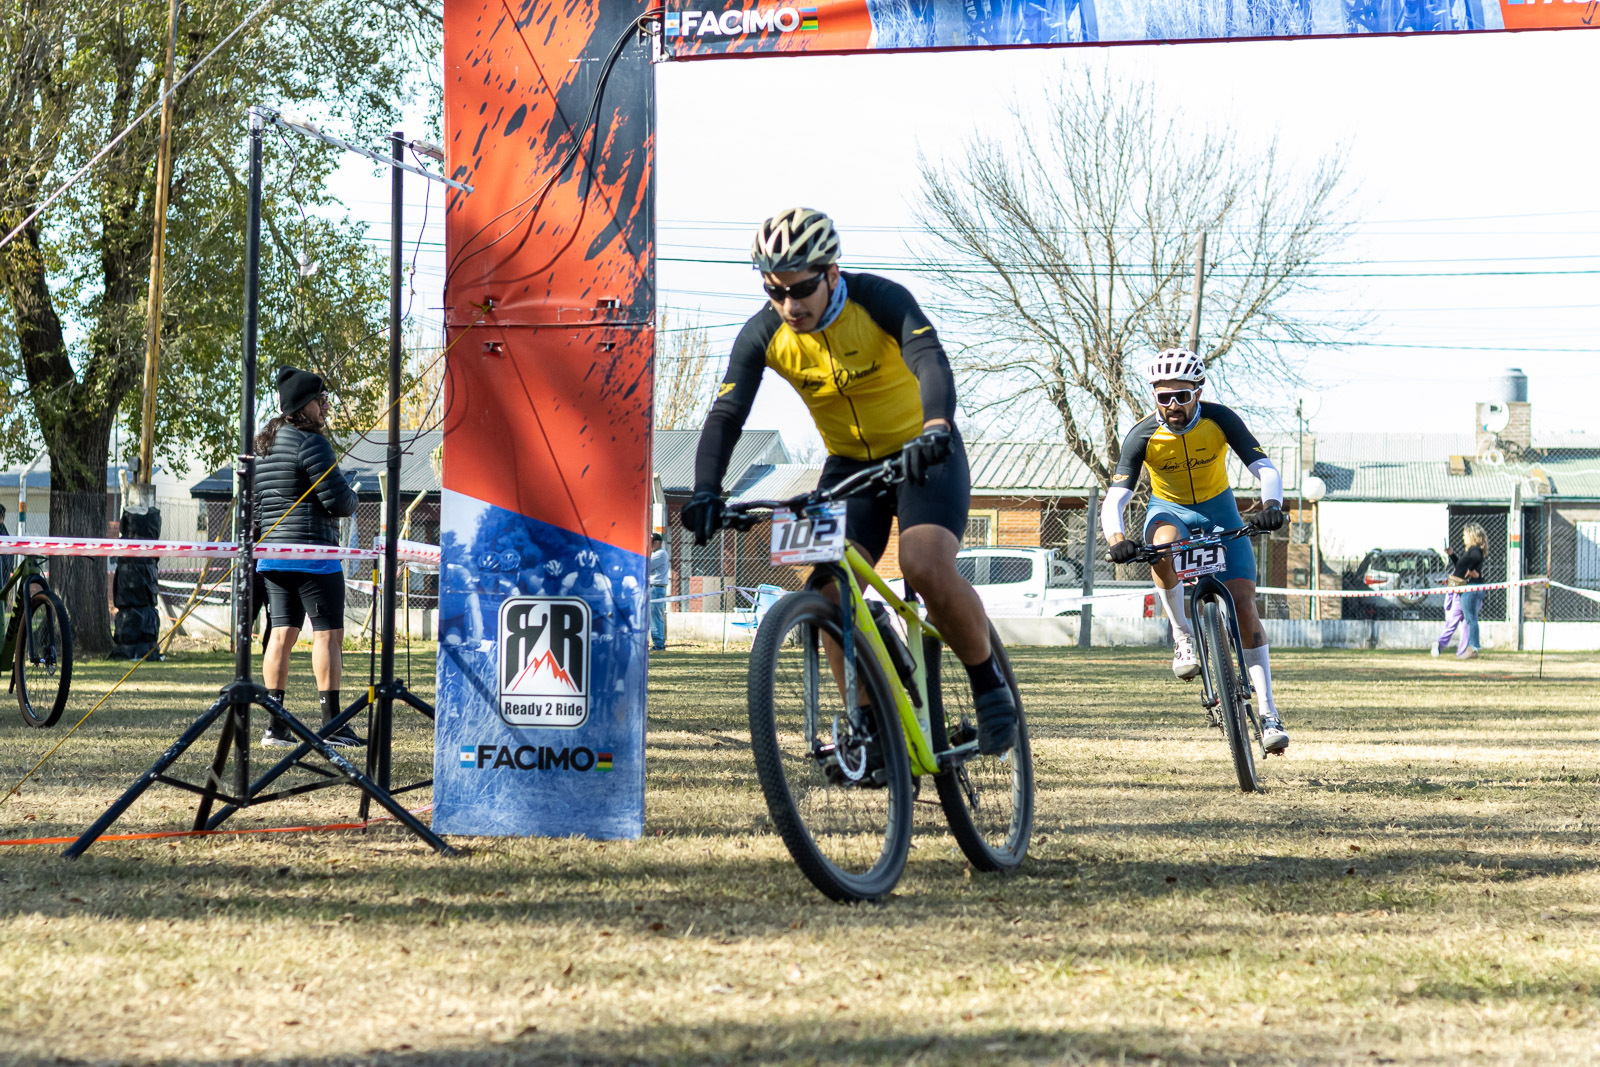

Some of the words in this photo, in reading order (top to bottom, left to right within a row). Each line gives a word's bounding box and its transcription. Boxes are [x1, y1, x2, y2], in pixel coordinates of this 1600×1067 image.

[681, 7, 800, 37] FACIMO
[779, 518, 838, 551] 102
[1177, 545, 1218, 571] 143
[504, 701, 542, 717] Ready
[545, 702, 553, 716] 2
[556, 702, 583, 716] Ride
[477, 744, 595, 772] FACIMO
